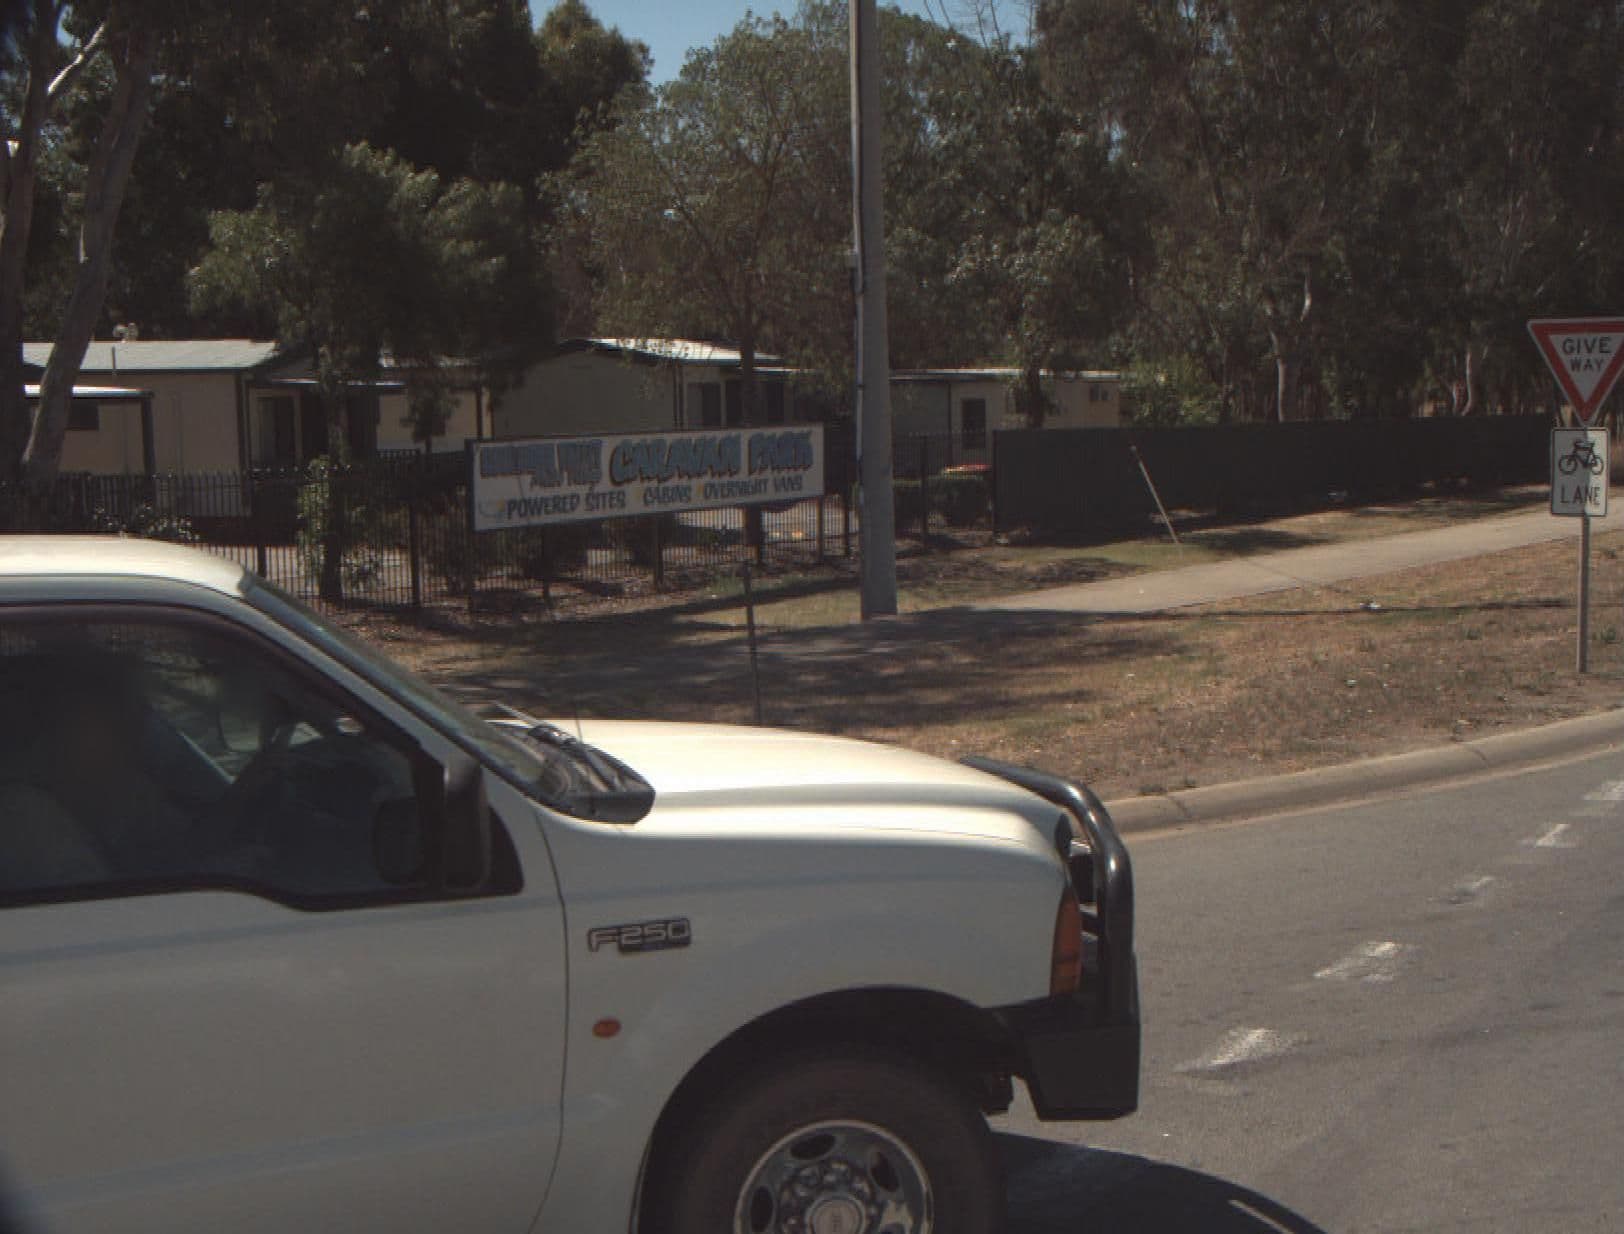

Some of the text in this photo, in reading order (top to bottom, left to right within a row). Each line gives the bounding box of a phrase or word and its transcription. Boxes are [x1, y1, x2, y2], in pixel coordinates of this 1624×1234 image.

[1562, 336, 1612, 354] GIVE
[1570, 357, 1604, 373] WAY
[609, 432, 742, 486] CARAVAN
[506, 473, 804, 520] POWERED SITES CABINS OVERNIGHT VANS
[1560, 484, 1601, 506] LANE
[587, 918, 692, 954] F250
